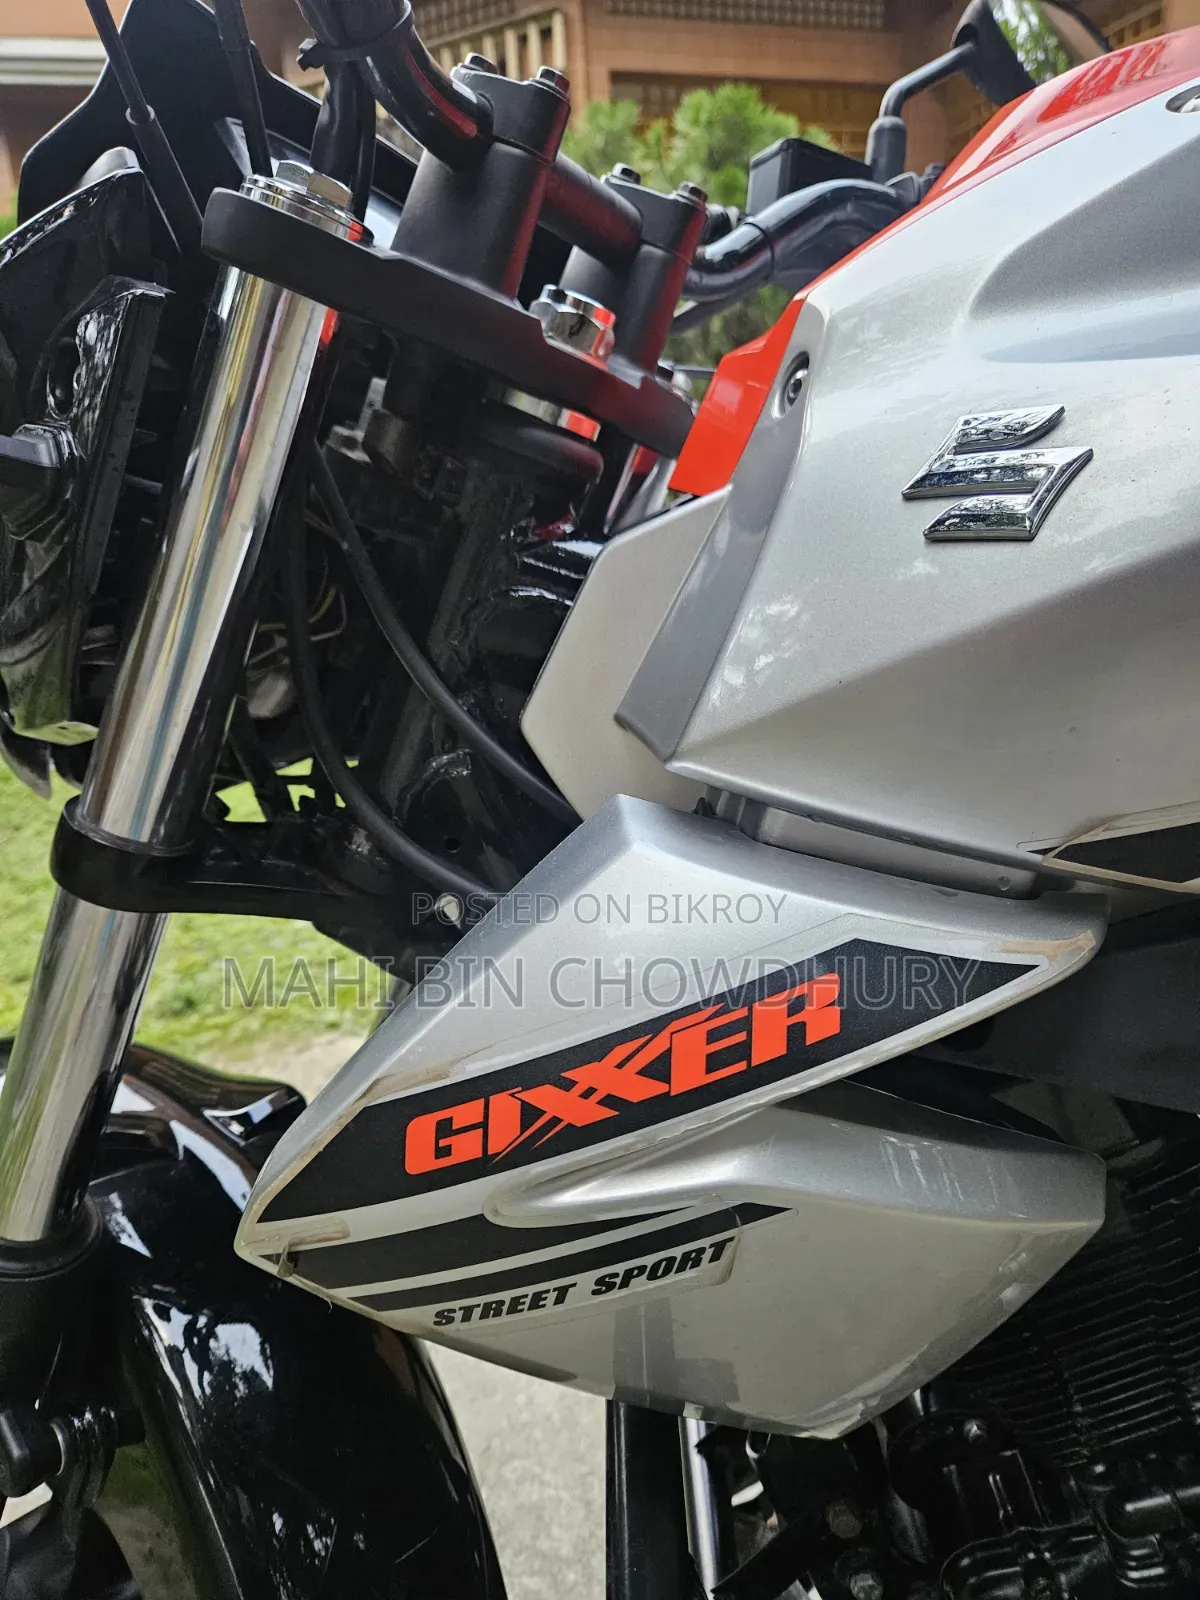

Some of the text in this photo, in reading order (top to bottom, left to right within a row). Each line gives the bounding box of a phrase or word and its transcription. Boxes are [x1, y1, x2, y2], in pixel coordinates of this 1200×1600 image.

[405, 972, 841, 1175] GIXXER
[433, 1237, 735, 1327] STREET SPORT
